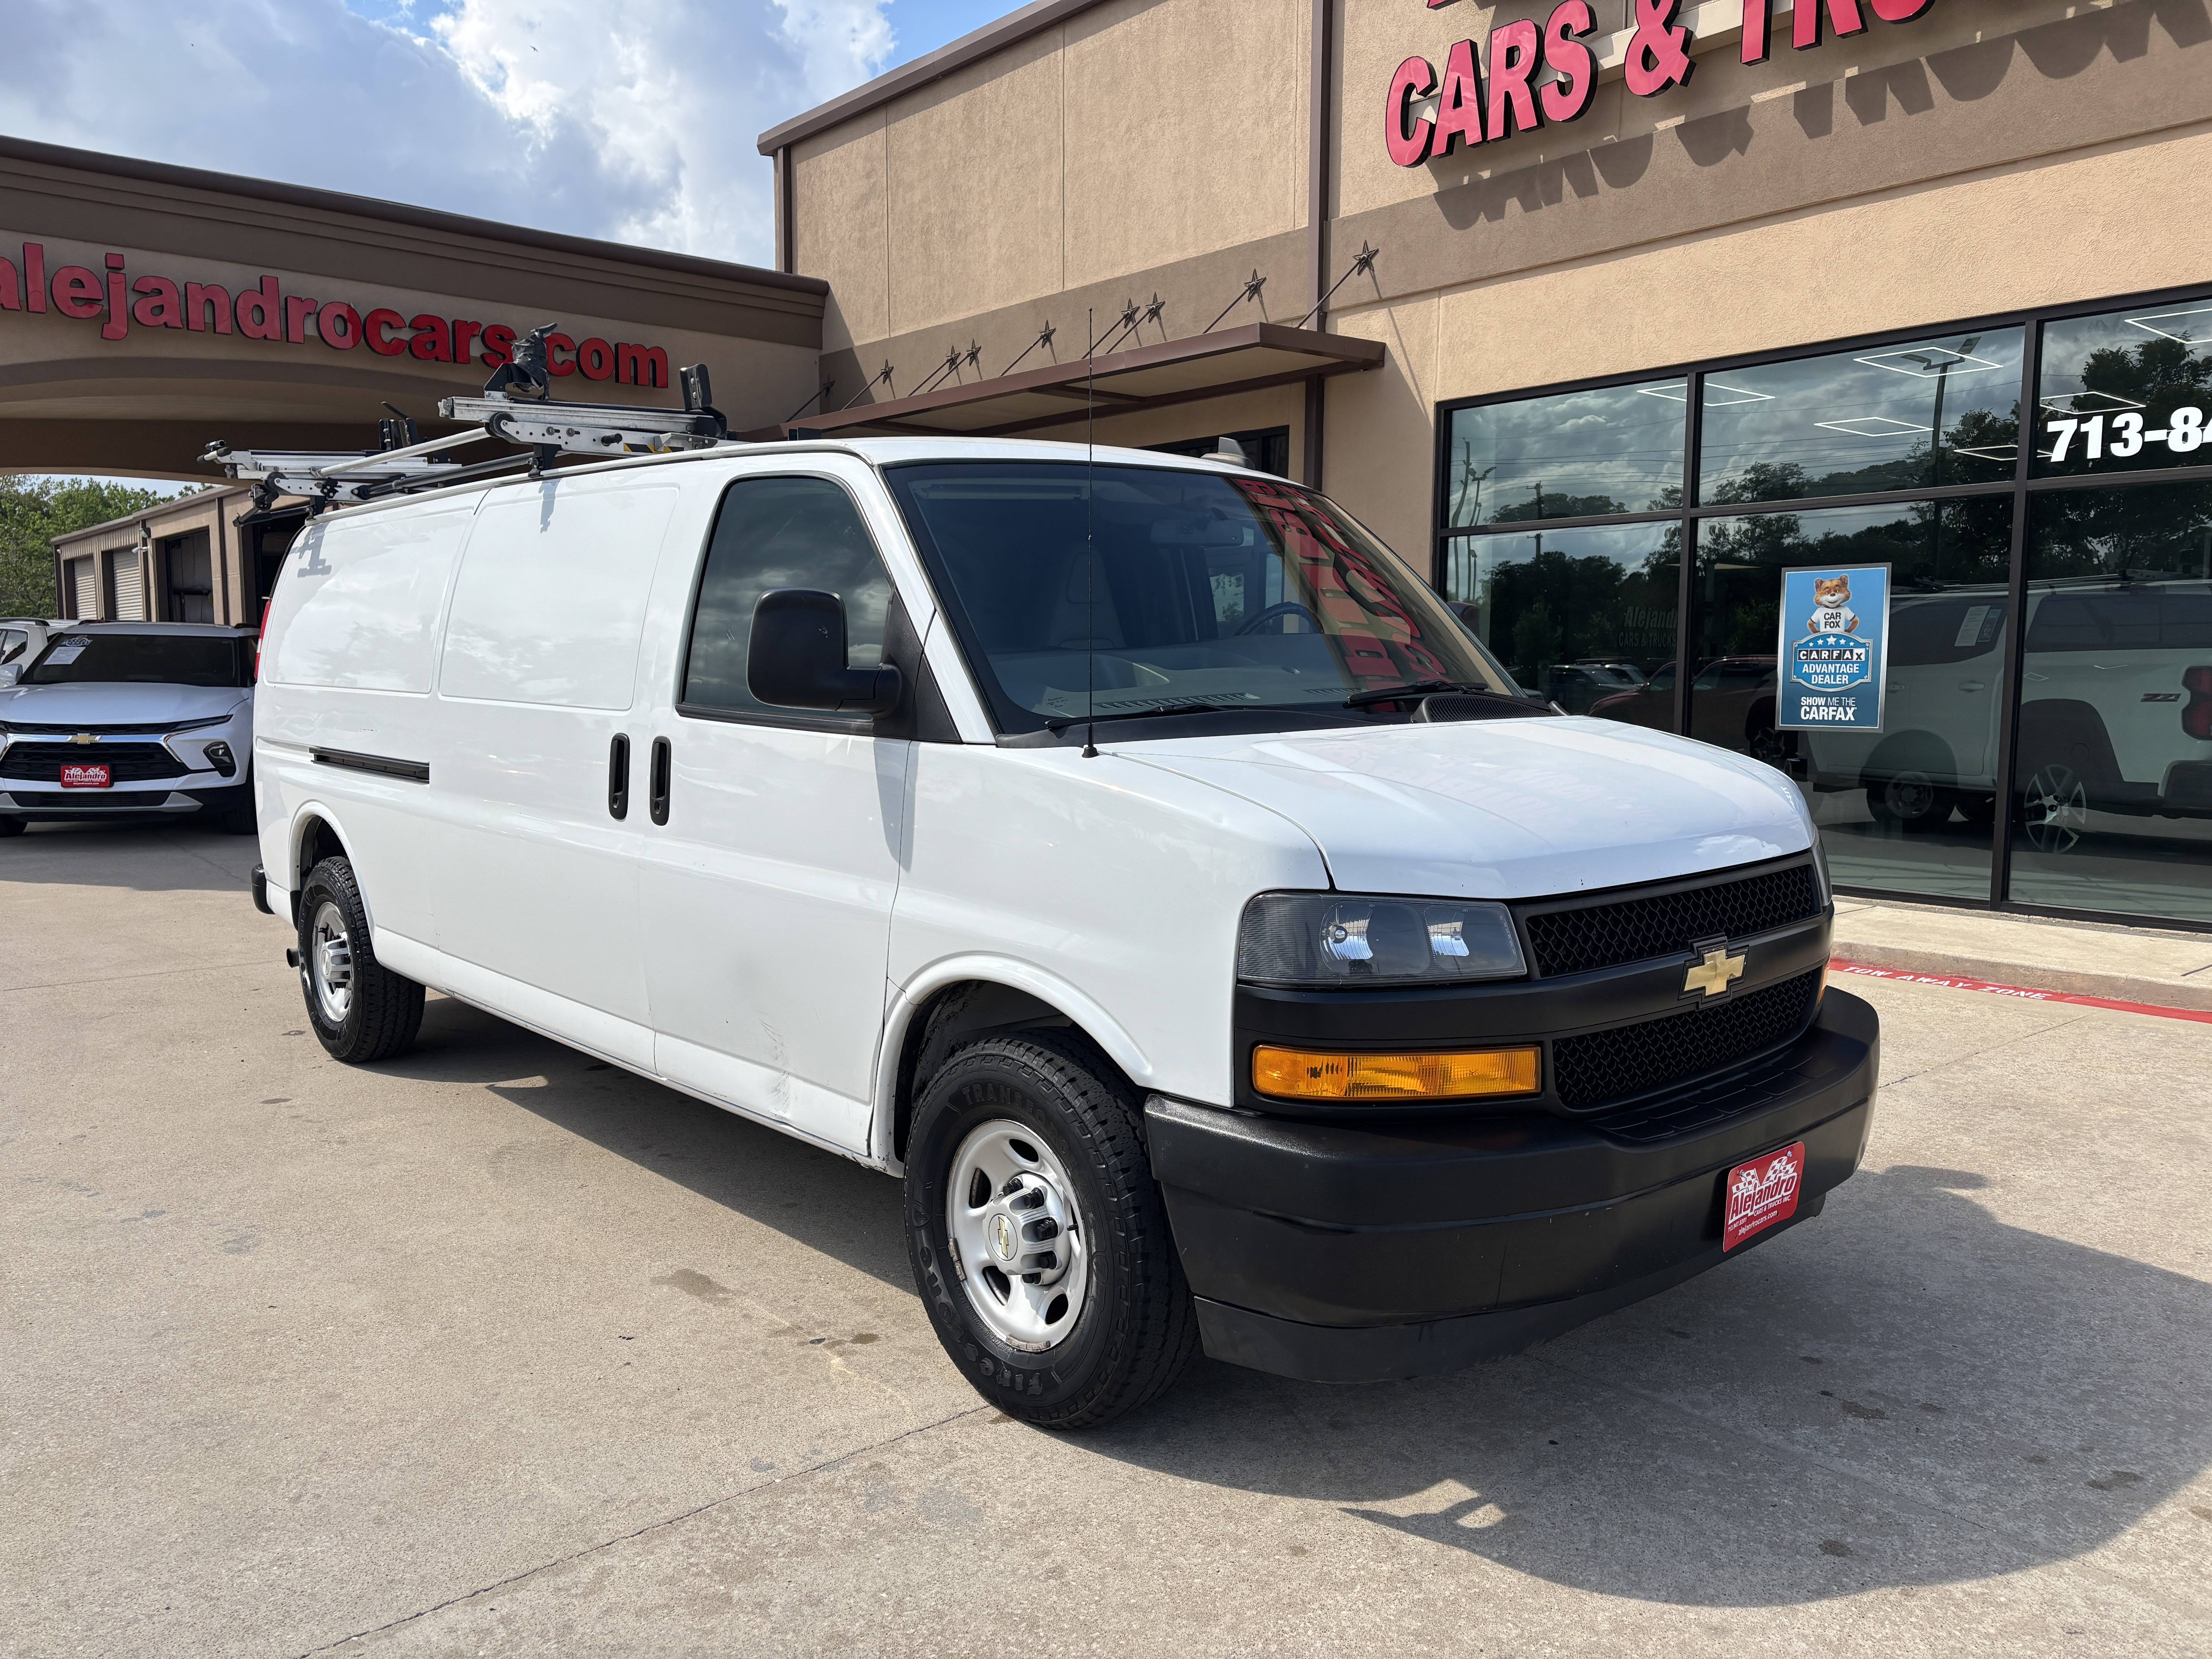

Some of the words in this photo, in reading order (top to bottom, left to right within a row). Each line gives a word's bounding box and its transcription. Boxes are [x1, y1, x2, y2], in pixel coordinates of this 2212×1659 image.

[1385, 0, 1598, 168] CARS
[1623, 0, 1697, 97] &
[2047, 406, 2212, 462] 713-8
[1824, 612, 1841, 620] CAR
[1824, 620, 1841, 629] FOX
[1619, 632, 1639, 647] CARS
[1641, 632, 1646, 647] &
[1799, 649, 1864, 661] CARFAX
[1802, 663, 1859, 673] ADVANTAGE
[1811, 675, 1849, 684] DEALER
[1801, 696, 1826, 706] SHOW
[1828, 697, 1839, 706] ME
[1841, 697, 1856, 706] THE
[1800, 706, 1855, 721] CARFAX
[64, 772, 107, 781] Alejandro
[1843, 967, 1893, 976] TOW
[1977, 986, 2052, 1000] ZONE
[1728, 1172, 1798, 1225] Alejandro
